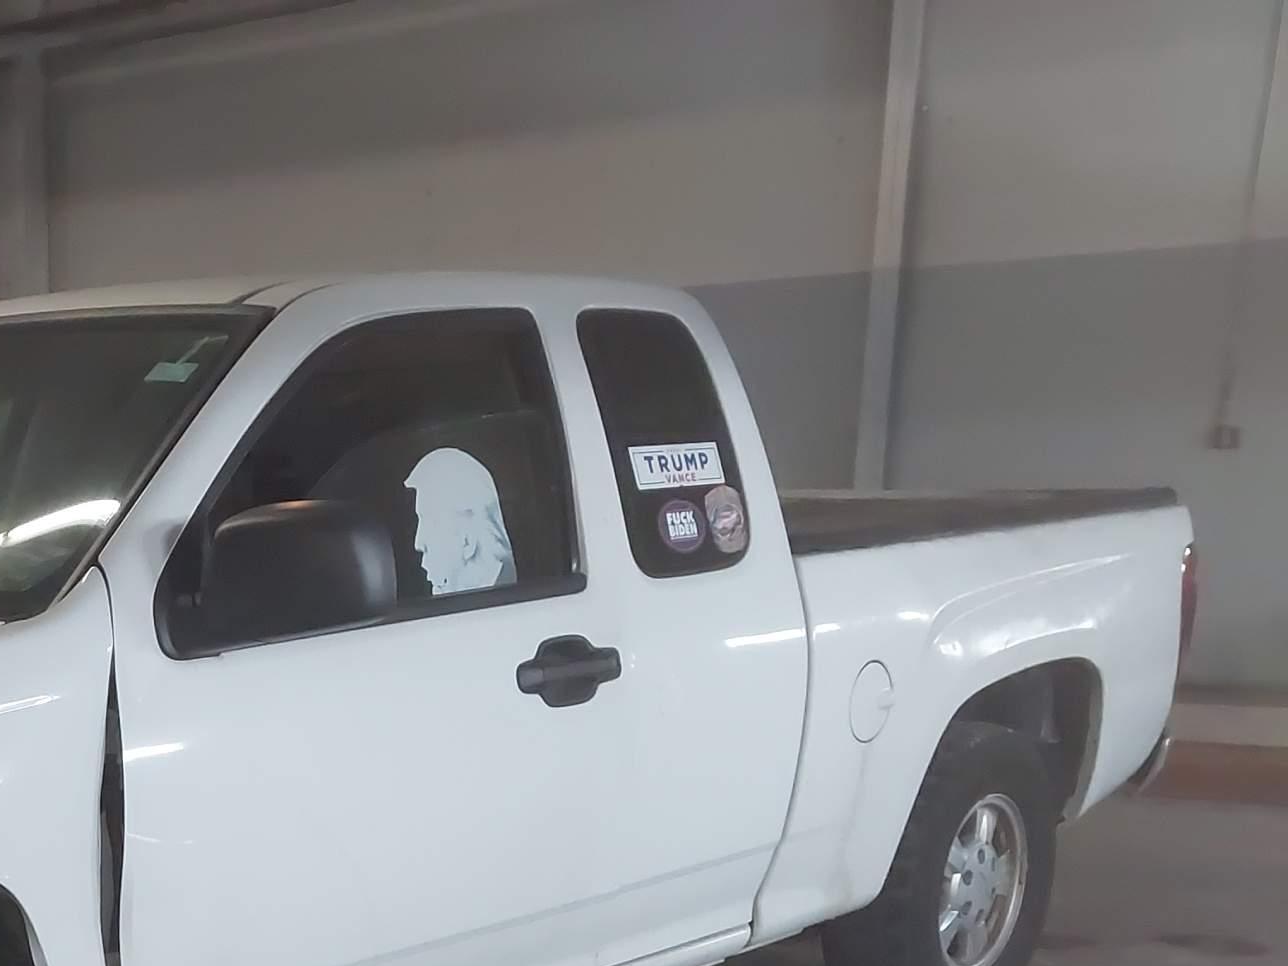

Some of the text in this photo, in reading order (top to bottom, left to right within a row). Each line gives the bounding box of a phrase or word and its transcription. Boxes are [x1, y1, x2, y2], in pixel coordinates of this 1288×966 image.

[643, 452, 709, 474] TRUMP
[665, 472, 697, 484] VANCE
[666, 510, 695, 525] FUCK
[669, 522, 698, 537] BIDEN
